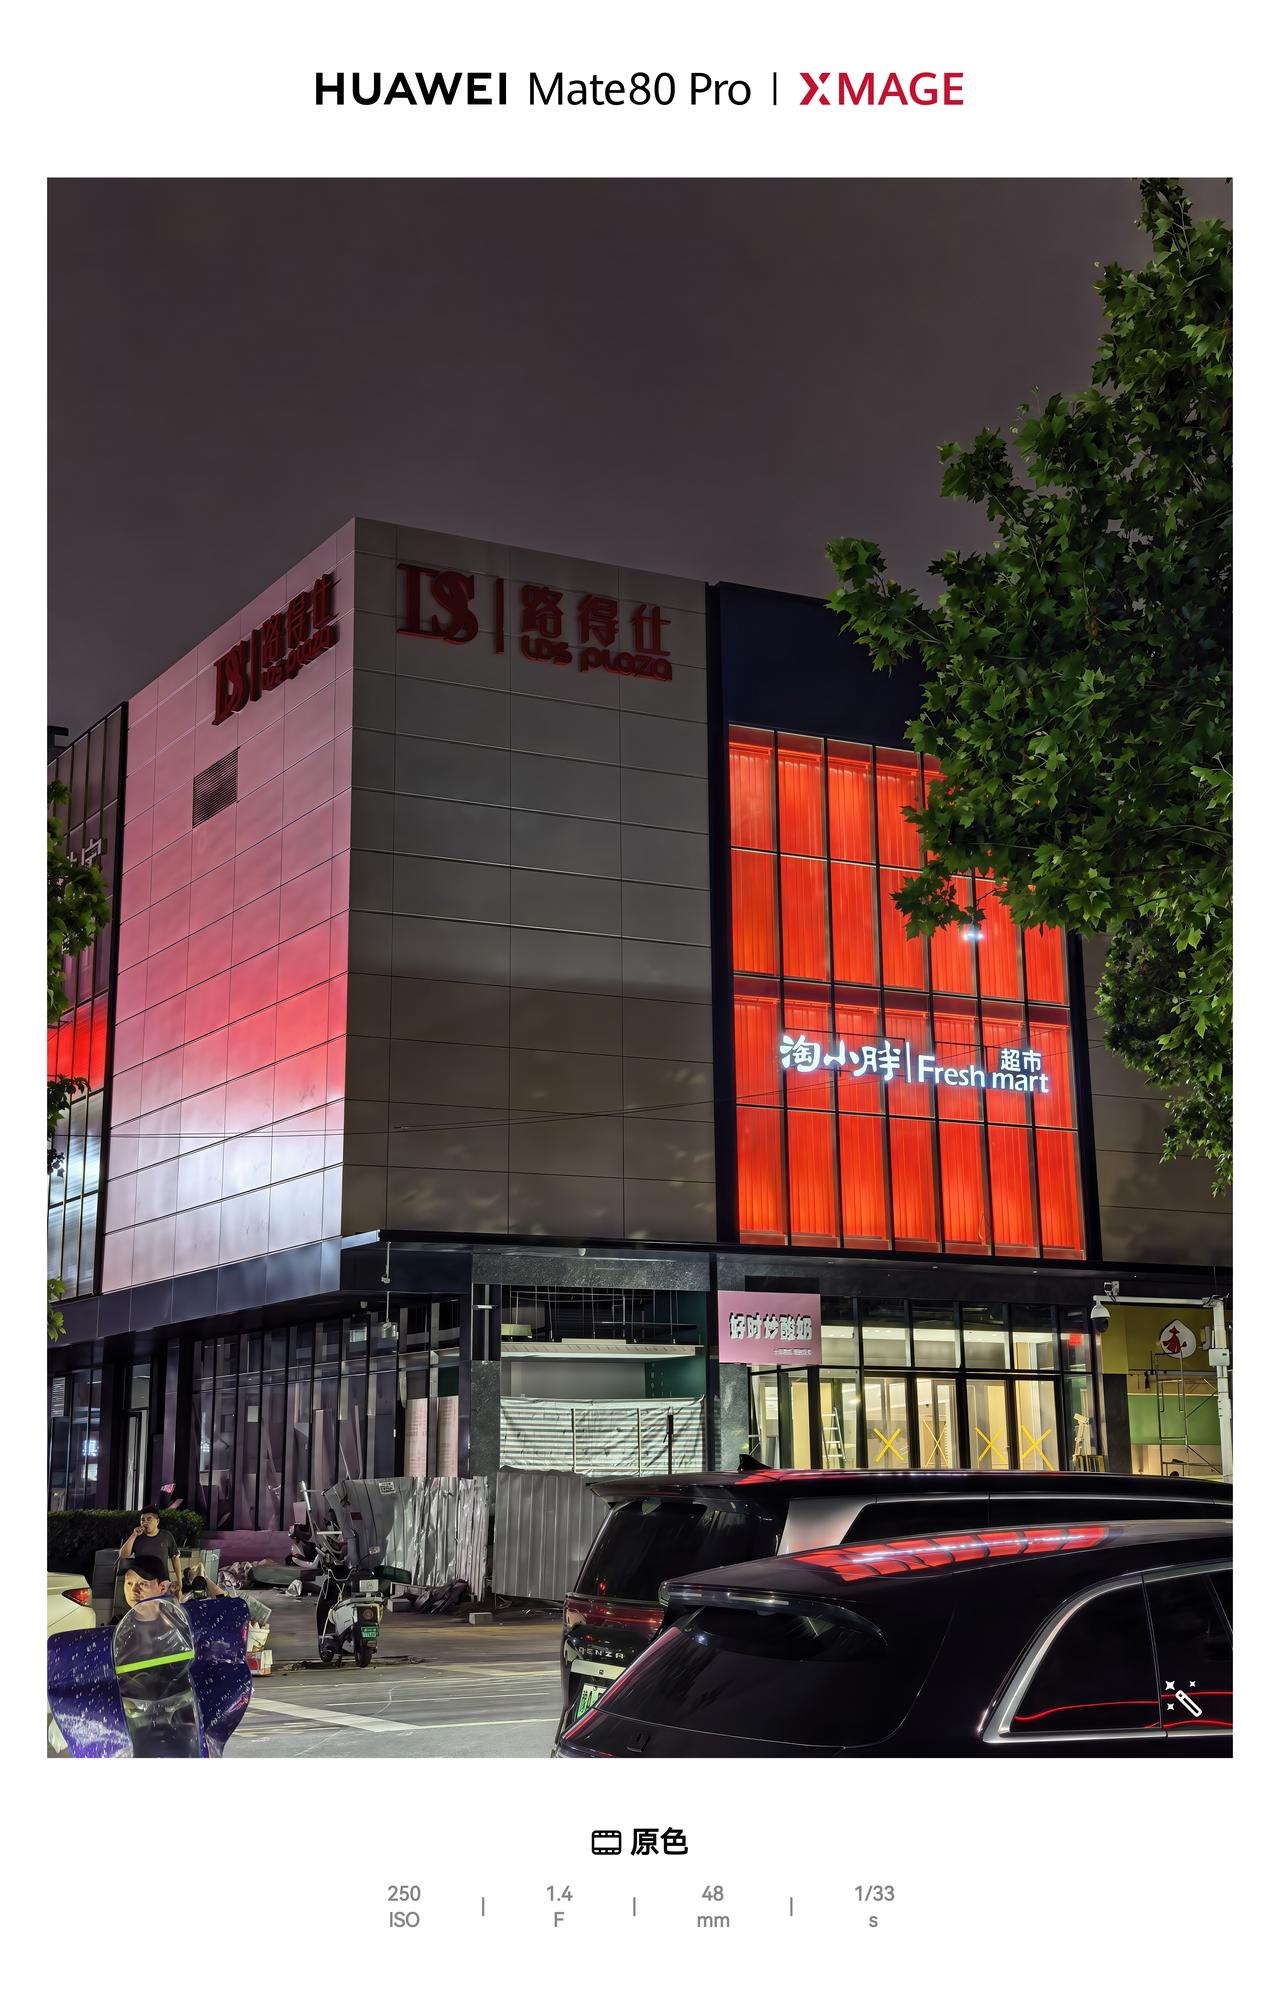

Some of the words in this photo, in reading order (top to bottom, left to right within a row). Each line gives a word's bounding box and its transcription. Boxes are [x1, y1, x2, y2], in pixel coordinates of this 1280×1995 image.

[263, 574, 341, 669] 路得仕
[520, 584, 672, 656] 路得仕
[779, 1034, 902, 1082] 淘小胖
[918, 1055, 986, 1088] Fresh
[991, 1072, 1050, 1094] mart
[1000, 1047, 1042, 1073] 超市
[730, 1313, 812, 1341] 好时炒酸奶
